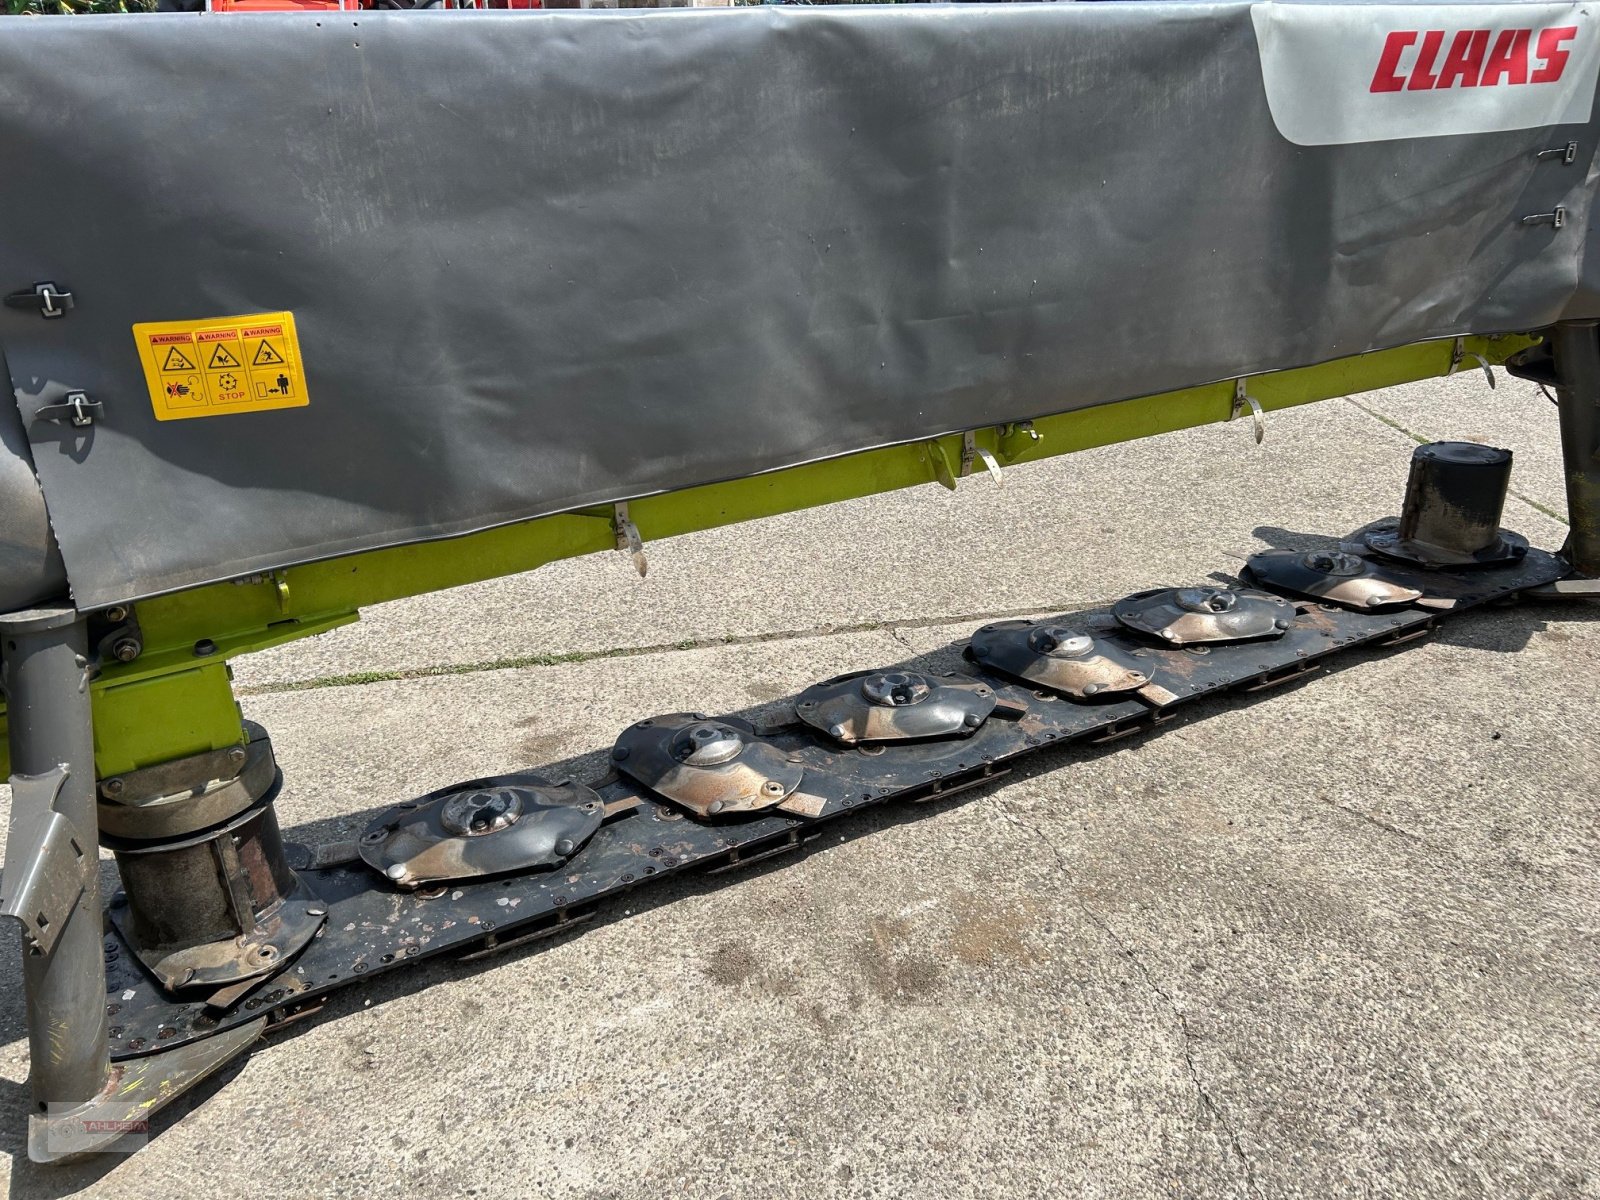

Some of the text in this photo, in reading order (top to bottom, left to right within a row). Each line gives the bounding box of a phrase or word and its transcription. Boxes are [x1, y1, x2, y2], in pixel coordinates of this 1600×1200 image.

[1369, 26, 1578, 93] CLAAS
[204, 331, 237, 340] WARNING
[249, 327, 281, 336] WARNING
[218, 391, 246, 401] STOP
